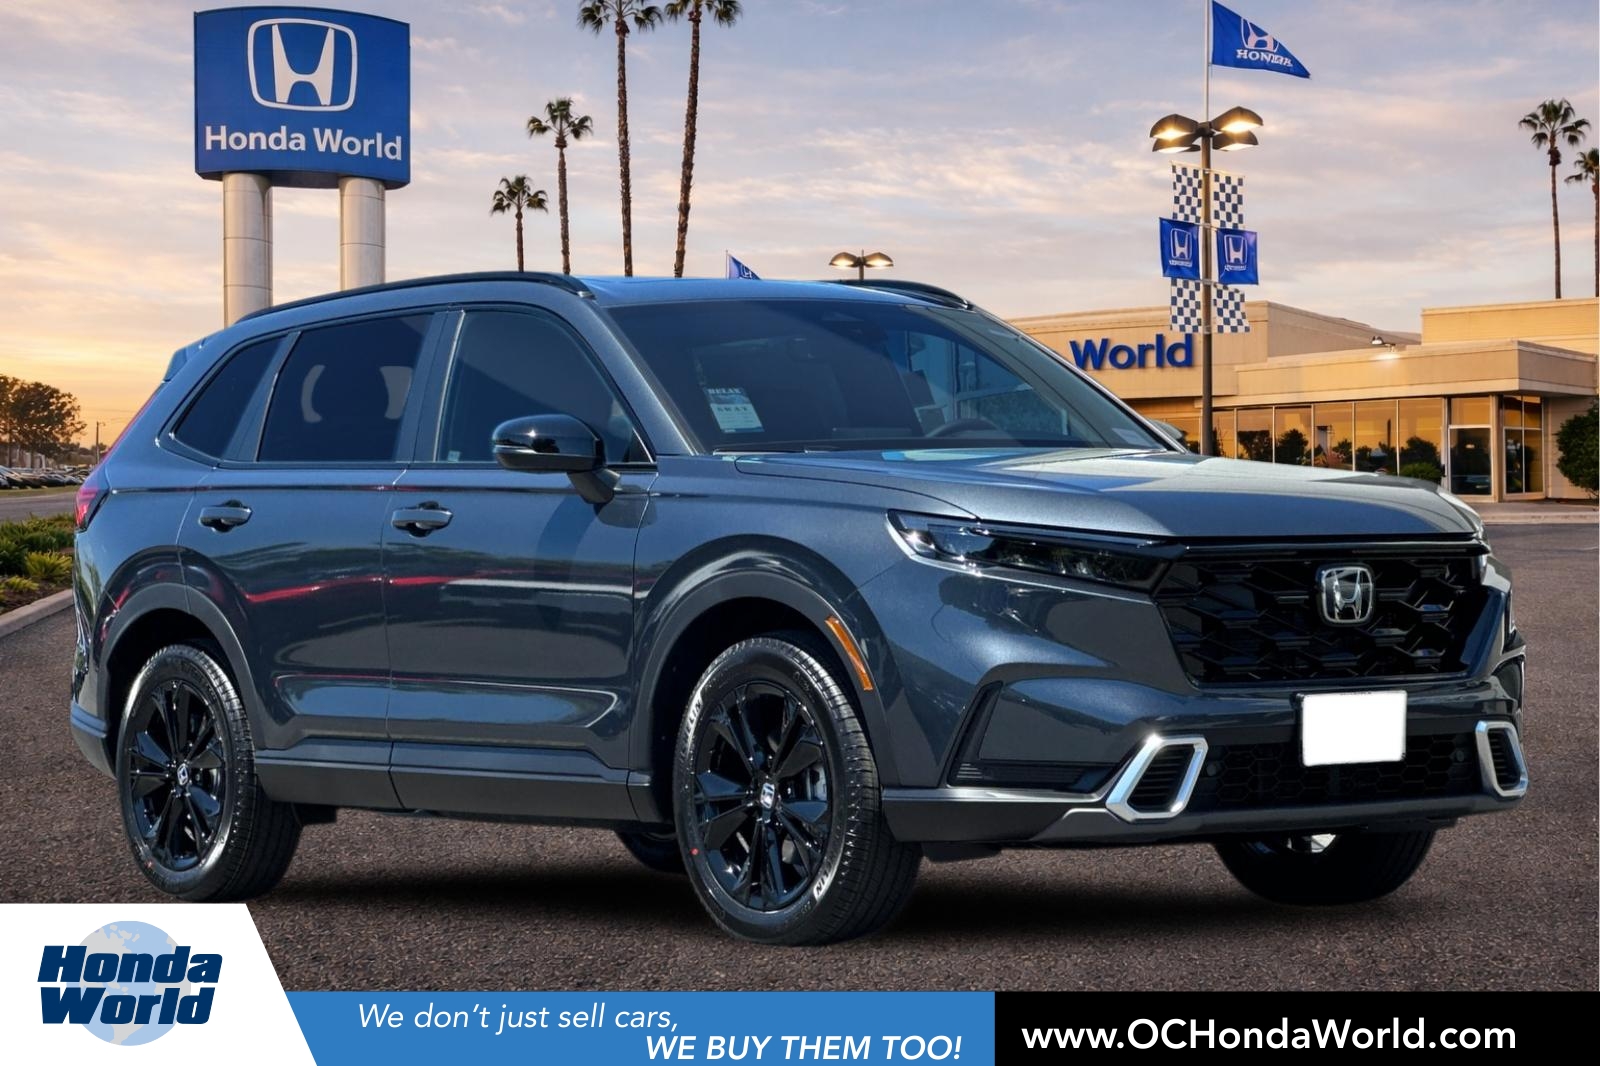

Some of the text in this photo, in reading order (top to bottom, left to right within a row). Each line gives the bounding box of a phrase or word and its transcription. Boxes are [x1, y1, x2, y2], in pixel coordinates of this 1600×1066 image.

[205, 125, 402, 161] Honda World
[1069, 333, 1193, 370] World
